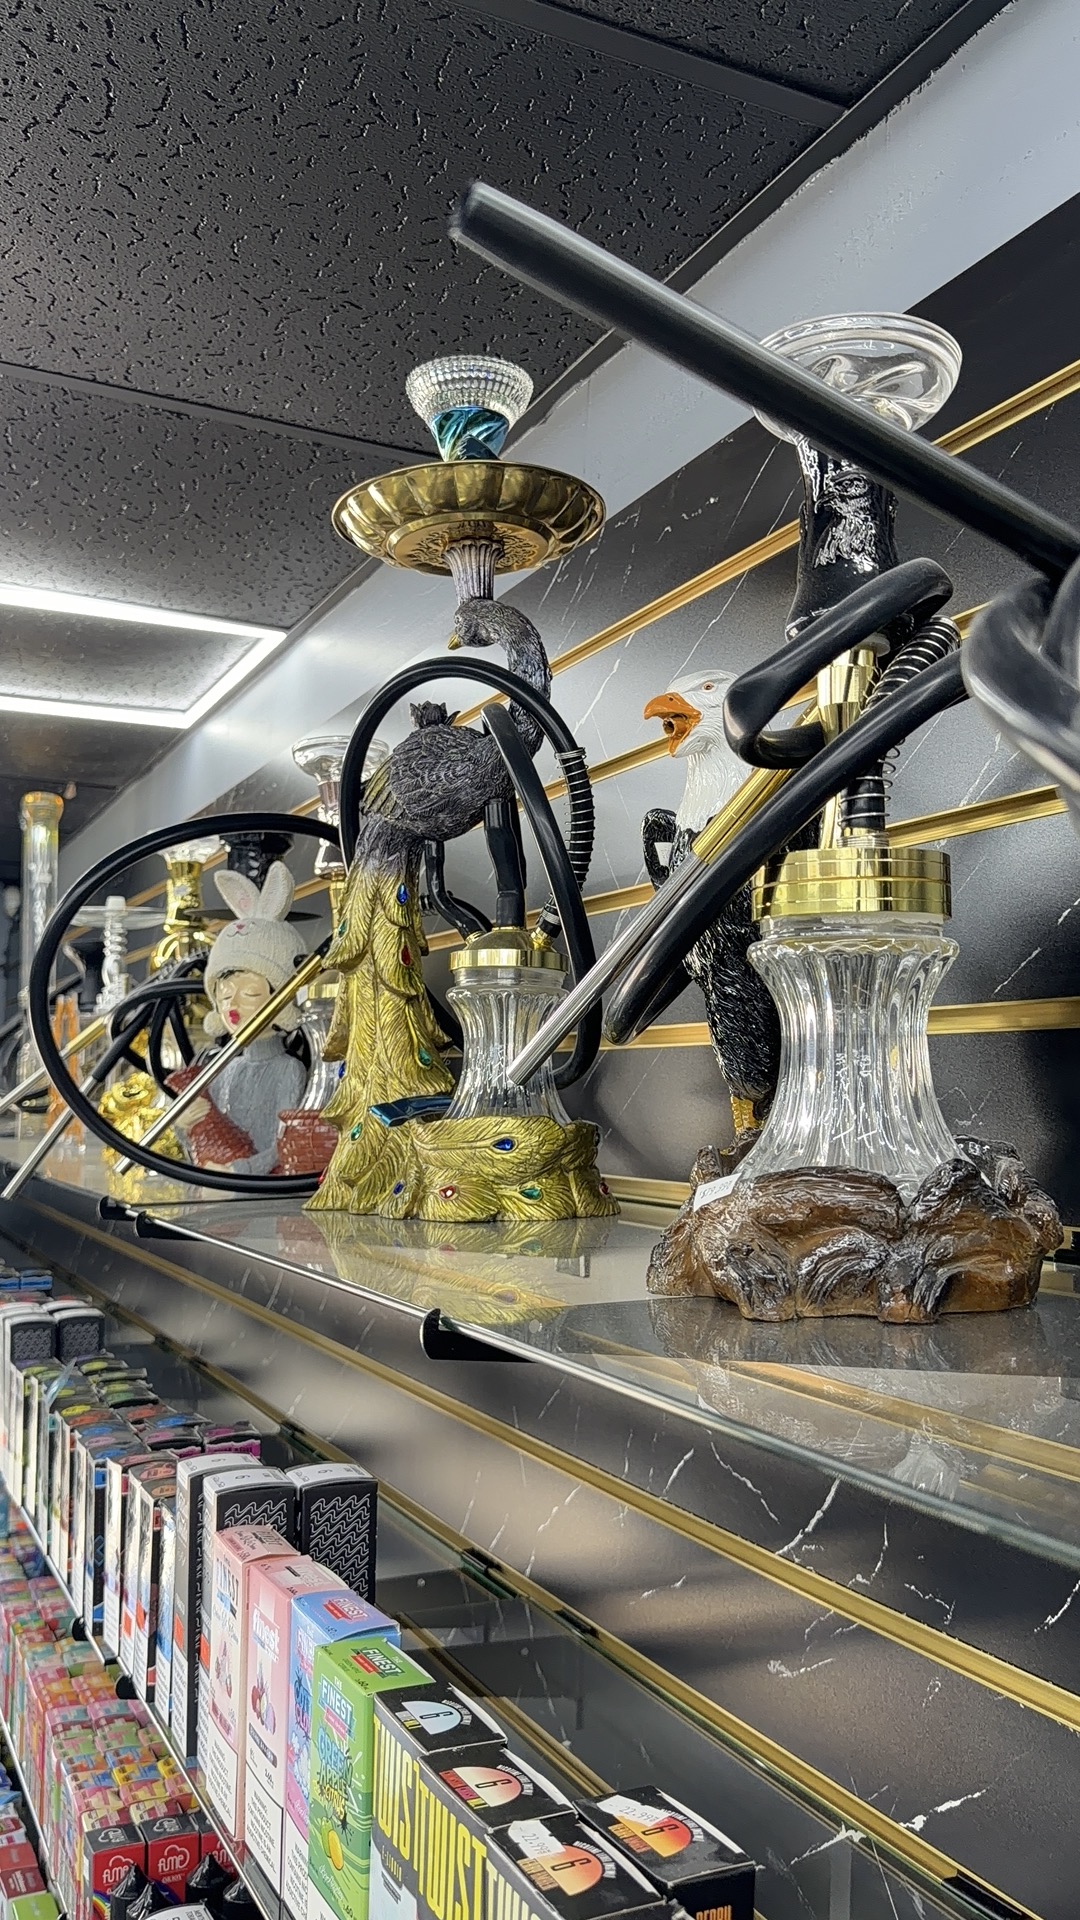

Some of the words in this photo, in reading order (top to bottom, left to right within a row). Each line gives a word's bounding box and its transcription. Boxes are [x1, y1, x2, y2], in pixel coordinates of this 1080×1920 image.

[253, 1608, 280, 1656] finest
[362, 1649, 402, 1676] FINEST
[334, 1676, 343, 1691] THE
[321, 1680, 353, 1724] FINEST
[419, 1711, 453, 1720] 6
[317, 1725, 353, 1787] GREEN
[318, 1762, 349, 1799] APPLE
[374, 1713, 420, 1872] TWIST
[475, 1778, 512, 1789] 6
[640, 1823, 680, 1836] 6
[419, 1779, 488, 1920] TWIST
[551, 1857, 592, 1872] 6
